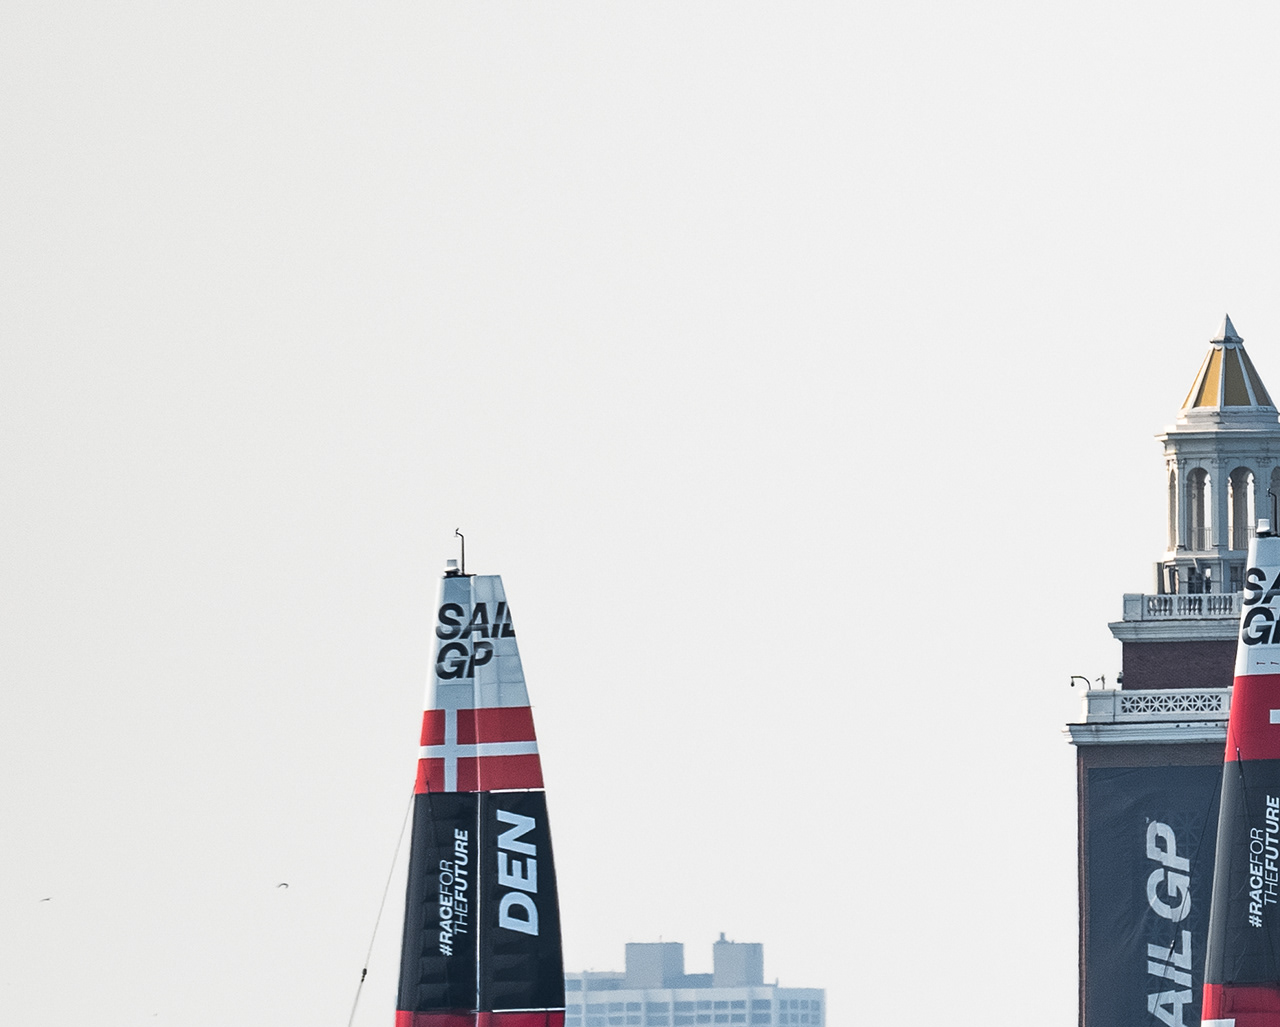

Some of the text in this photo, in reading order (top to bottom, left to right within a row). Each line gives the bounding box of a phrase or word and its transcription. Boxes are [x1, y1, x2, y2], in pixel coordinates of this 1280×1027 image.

[435, 602, 516, 640] SAIL
[435, 641, 493, 680] GP
[454, 828, 468, 936] THEFUTURE
[496, 809, 539, 936] DEN
[1146, 820, 1192, 922] GP
[1248, 827, 1264, 928] #RACEFOR
[1264, 795, 1280, 904] THEFUTURE
[439, 859, 453, 956] #RACEFOR
